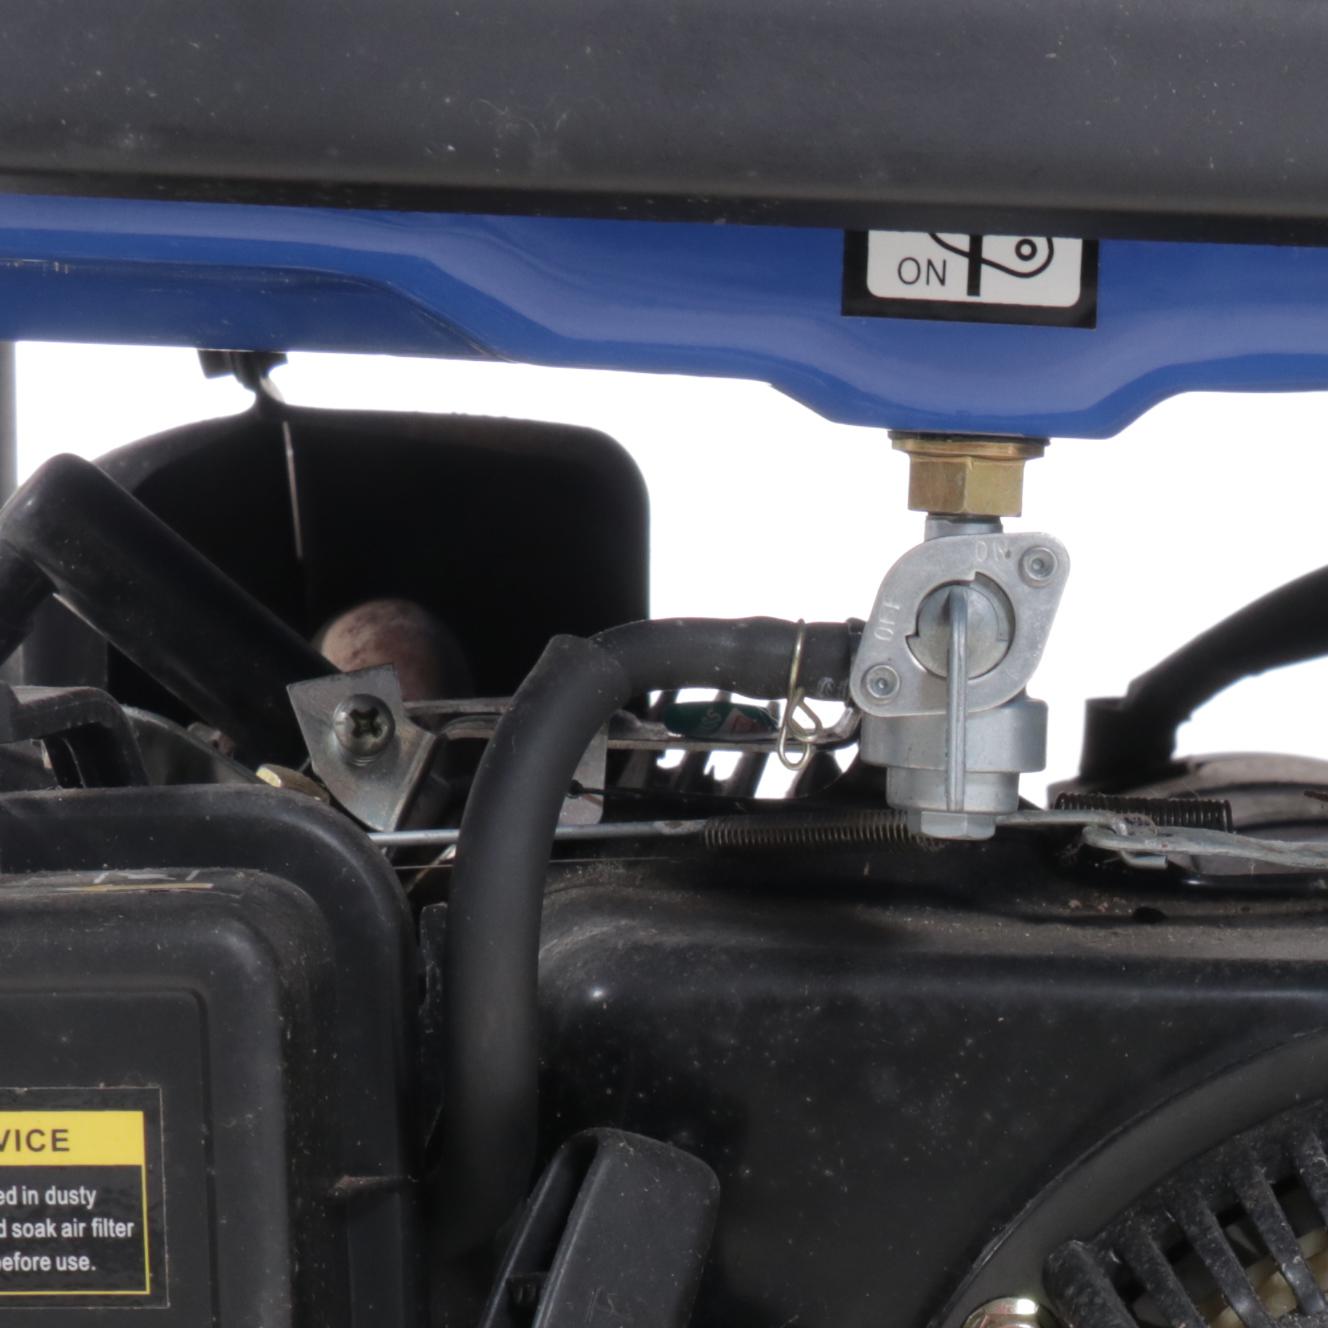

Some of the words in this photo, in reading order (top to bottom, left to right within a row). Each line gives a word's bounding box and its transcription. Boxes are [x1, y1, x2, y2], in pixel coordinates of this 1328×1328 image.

[897, 256, 947, 287] ON
[22, 1185, 39, 1206] in
[45, 1185, 97, 1210] dusty
[11, 1218, 58, 1238] soak
[61, 1218, 86, 1238] air
[91, 1218, 135, 1238] filter
[0, 1251, 51, 1272] efore
[55, 1254, 97, 1272] use.
